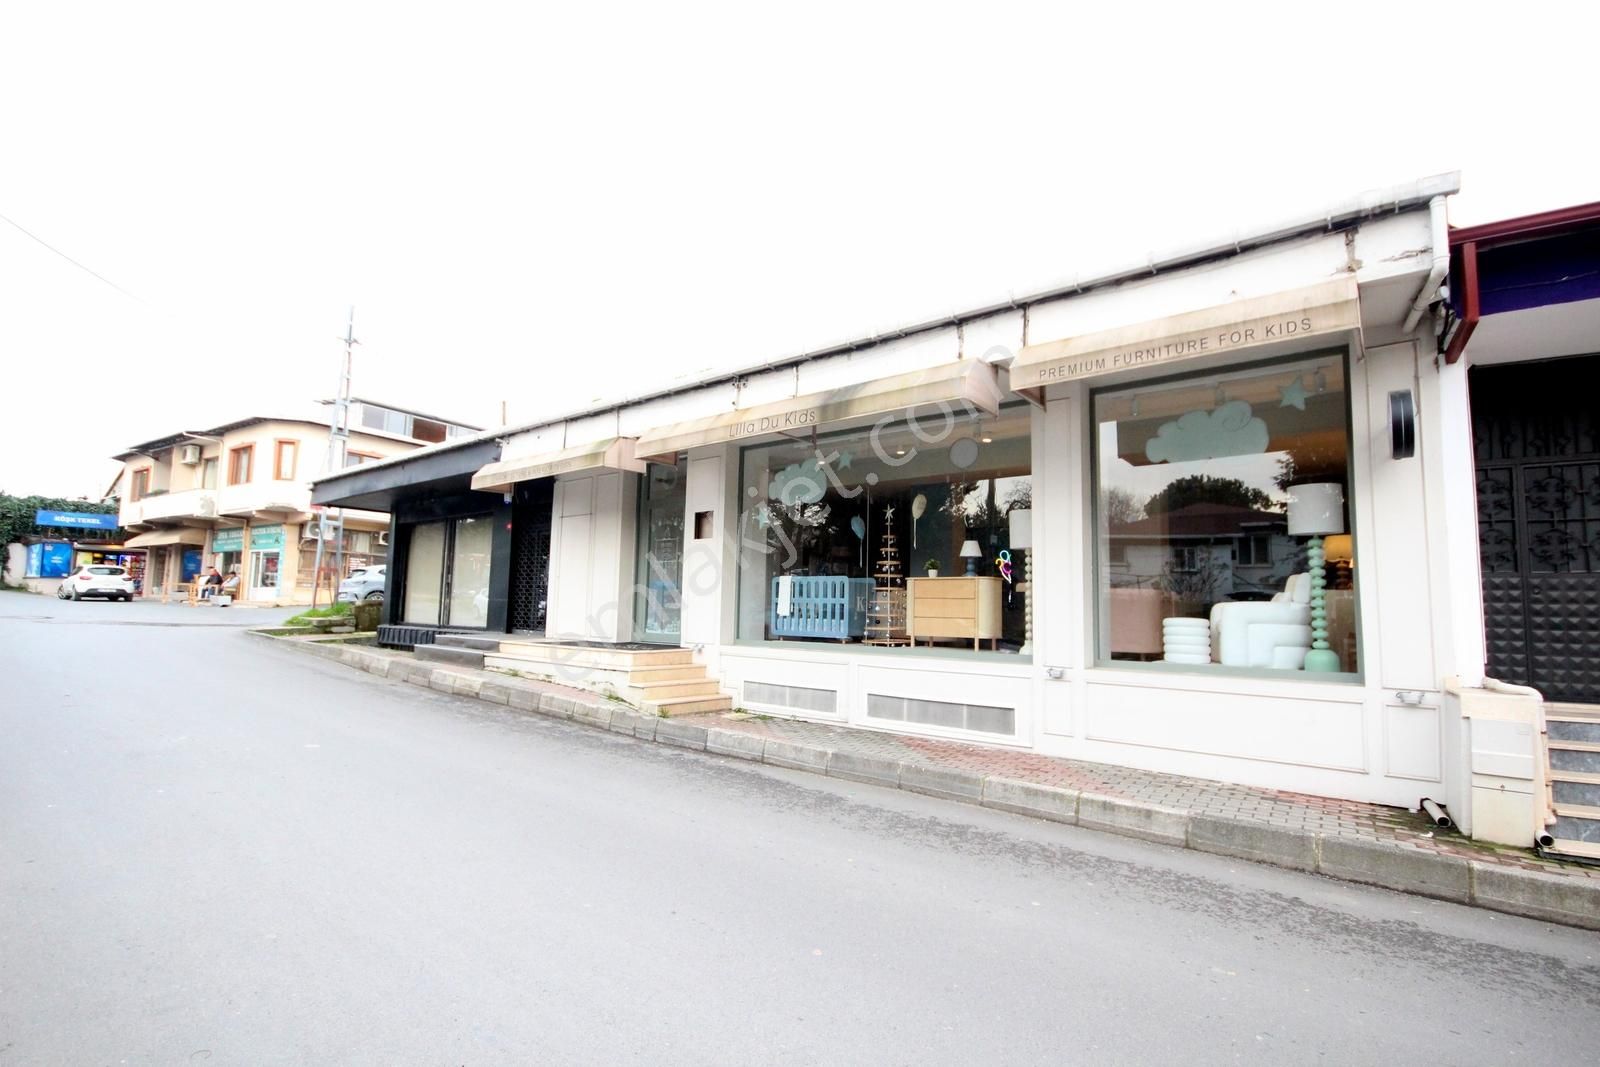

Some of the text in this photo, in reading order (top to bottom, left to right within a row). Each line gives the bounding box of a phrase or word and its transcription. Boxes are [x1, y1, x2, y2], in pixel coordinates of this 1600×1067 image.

[1039, 317, 1312, 379] PREMIUM FURNITURE FOR KIDS
[760, 416, 779, 431] Du
[784, 409, 816, 426] Kids
